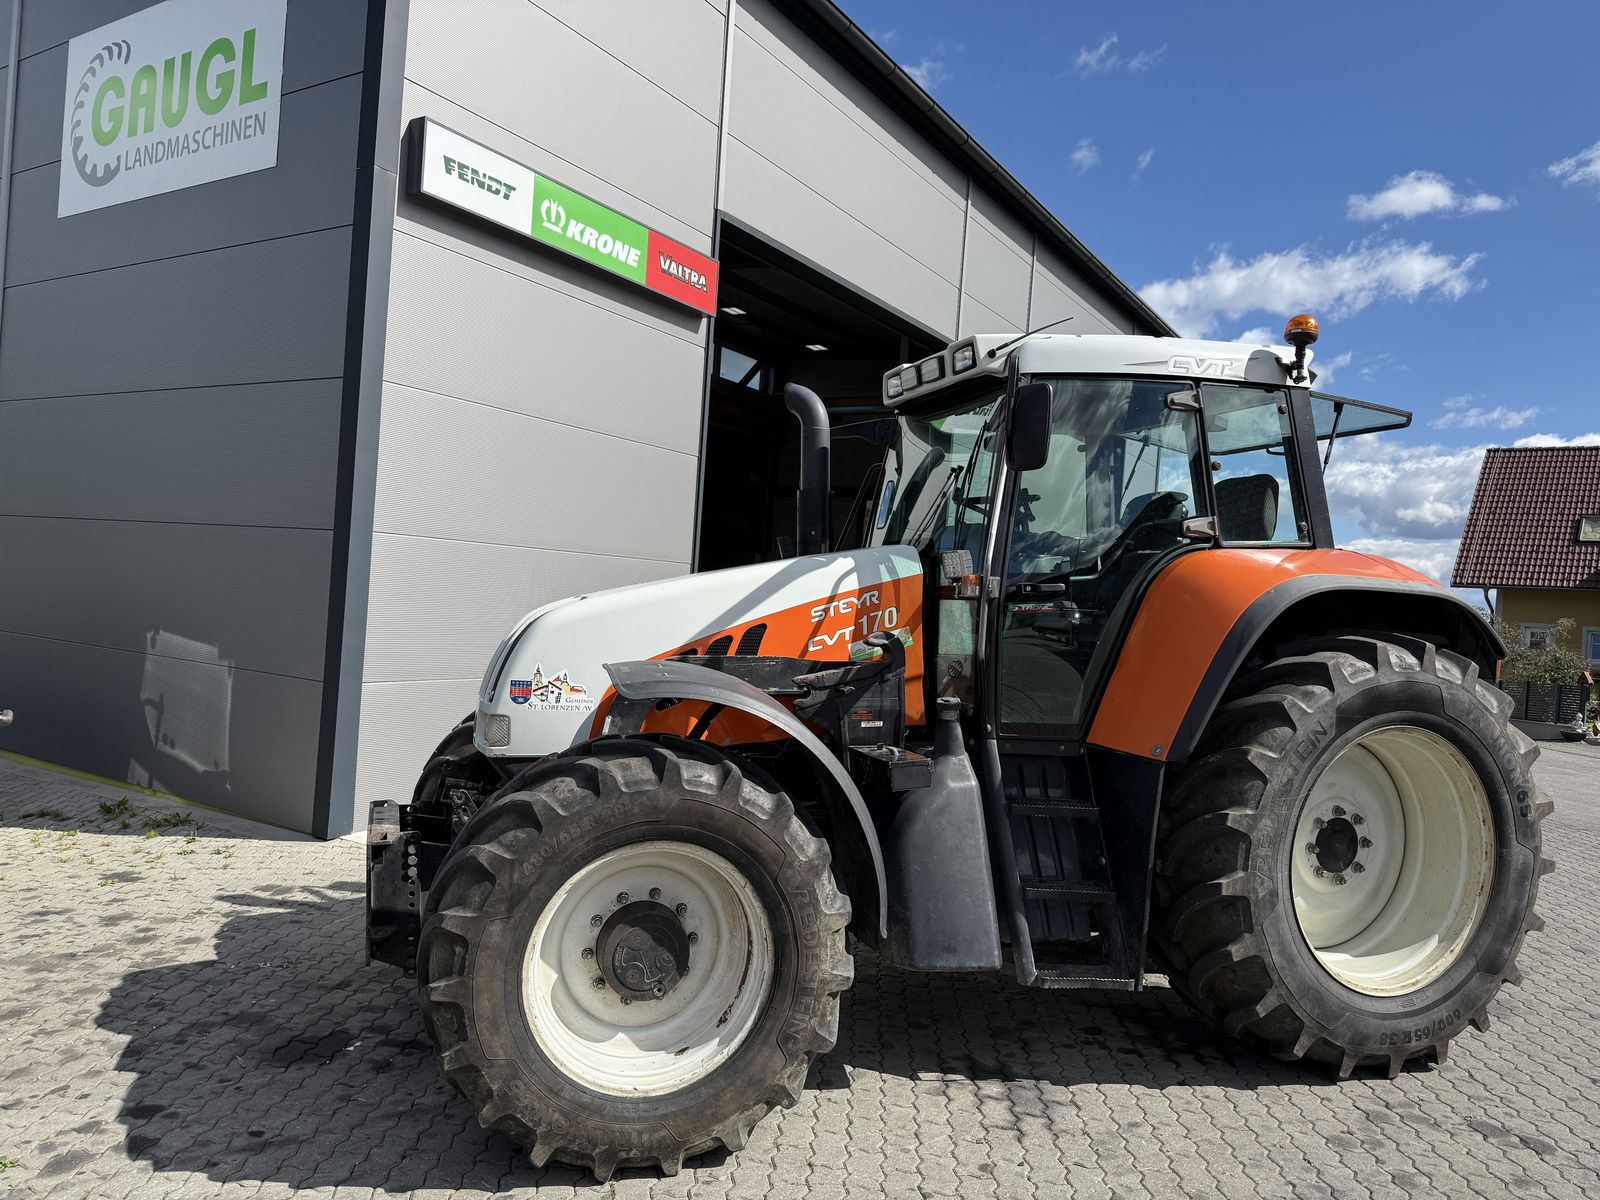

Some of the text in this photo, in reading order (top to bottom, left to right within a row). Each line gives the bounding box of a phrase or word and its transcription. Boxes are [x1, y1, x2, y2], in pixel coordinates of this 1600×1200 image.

[91, 27, 268, 147] GAUGL
[124, 111, 266, 171] LANDMASCHINEN
[443, 154, 516, 201] FENDT
[566, 217, 641, 268] KRONE
[658, 250, 708, 293] VALTRA
[1167, 354, 1234, 377] CVT
[807, 606, 898, 652] CVT 170
[810, 590, 881, 623] STEYR
